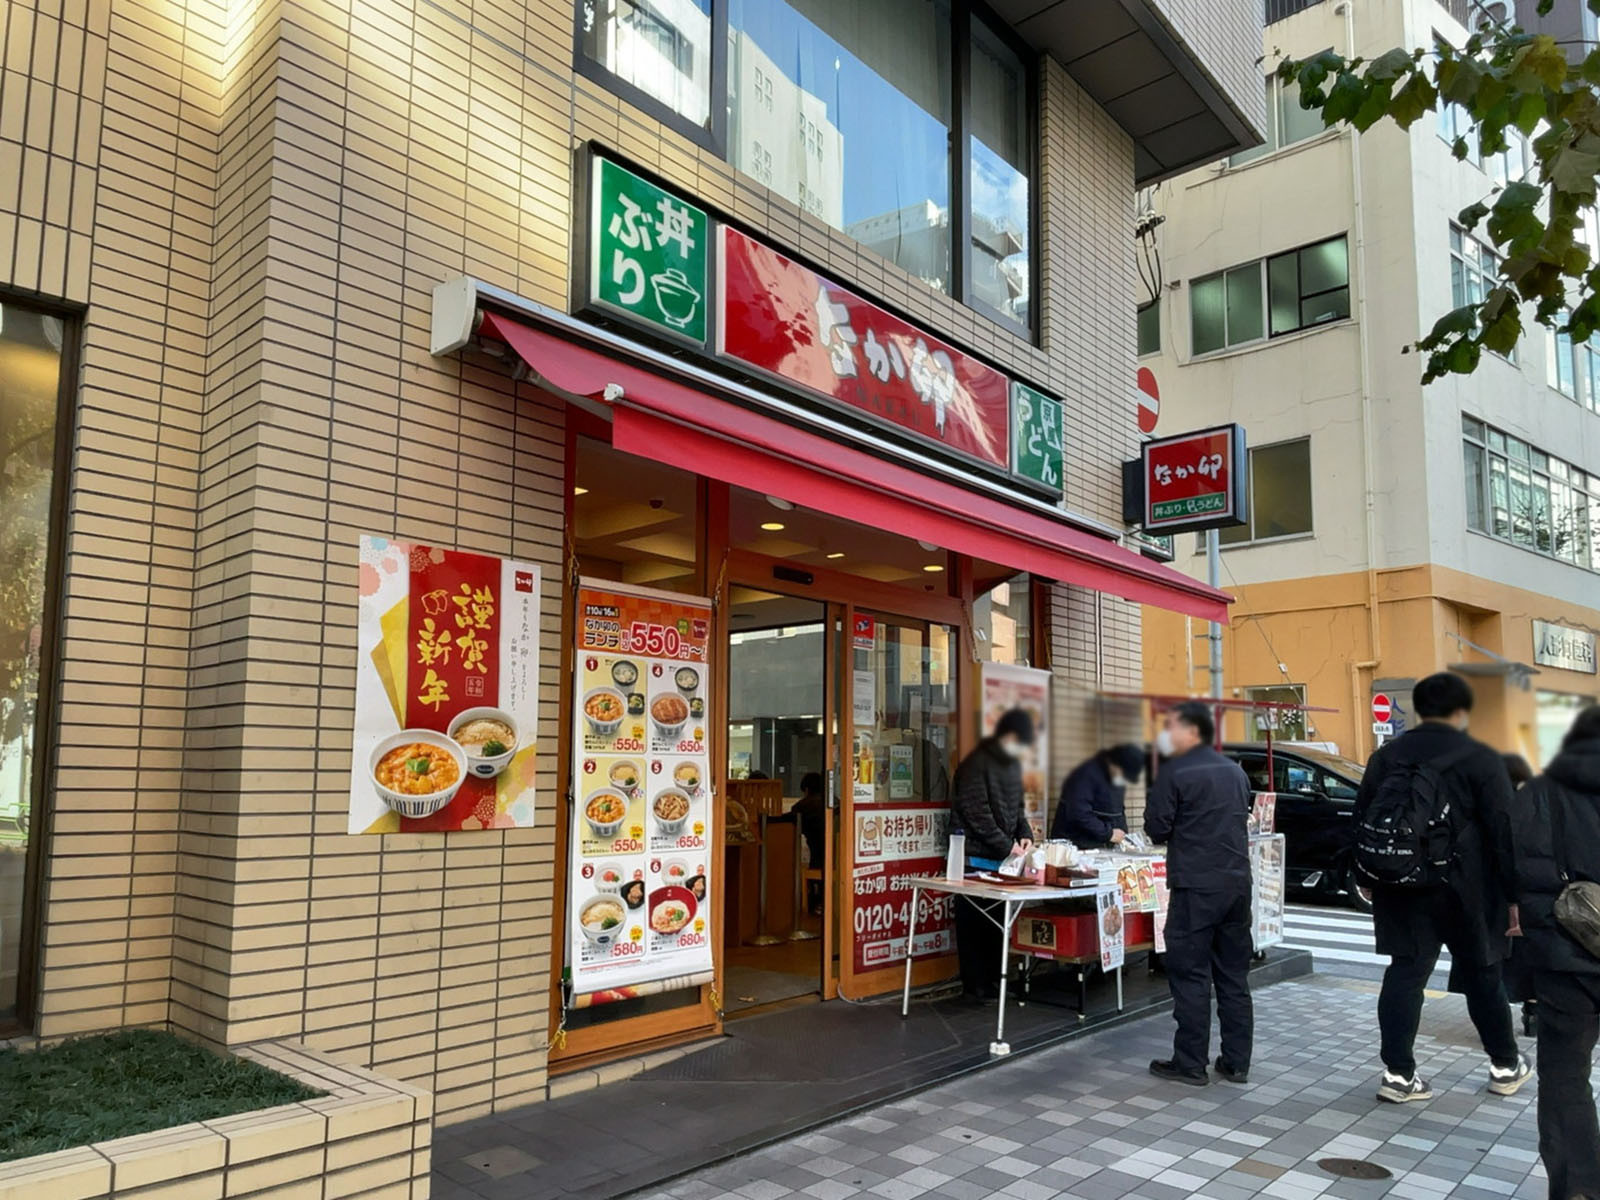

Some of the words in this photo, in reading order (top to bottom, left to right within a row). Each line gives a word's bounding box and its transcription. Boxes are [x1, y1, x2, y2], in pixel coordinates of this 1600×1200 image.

[1154, 454, 1223, 486] なか卯
[416, 617, 452, 713] 新年
[616, 738, 644, 751] 550円
[884, 816, 933, 838] お持ち帰り
[615, 839, 643, 852] 550円
[854, 875, 886, 895] なか卯
[614, 942, 643, 957] 580円
